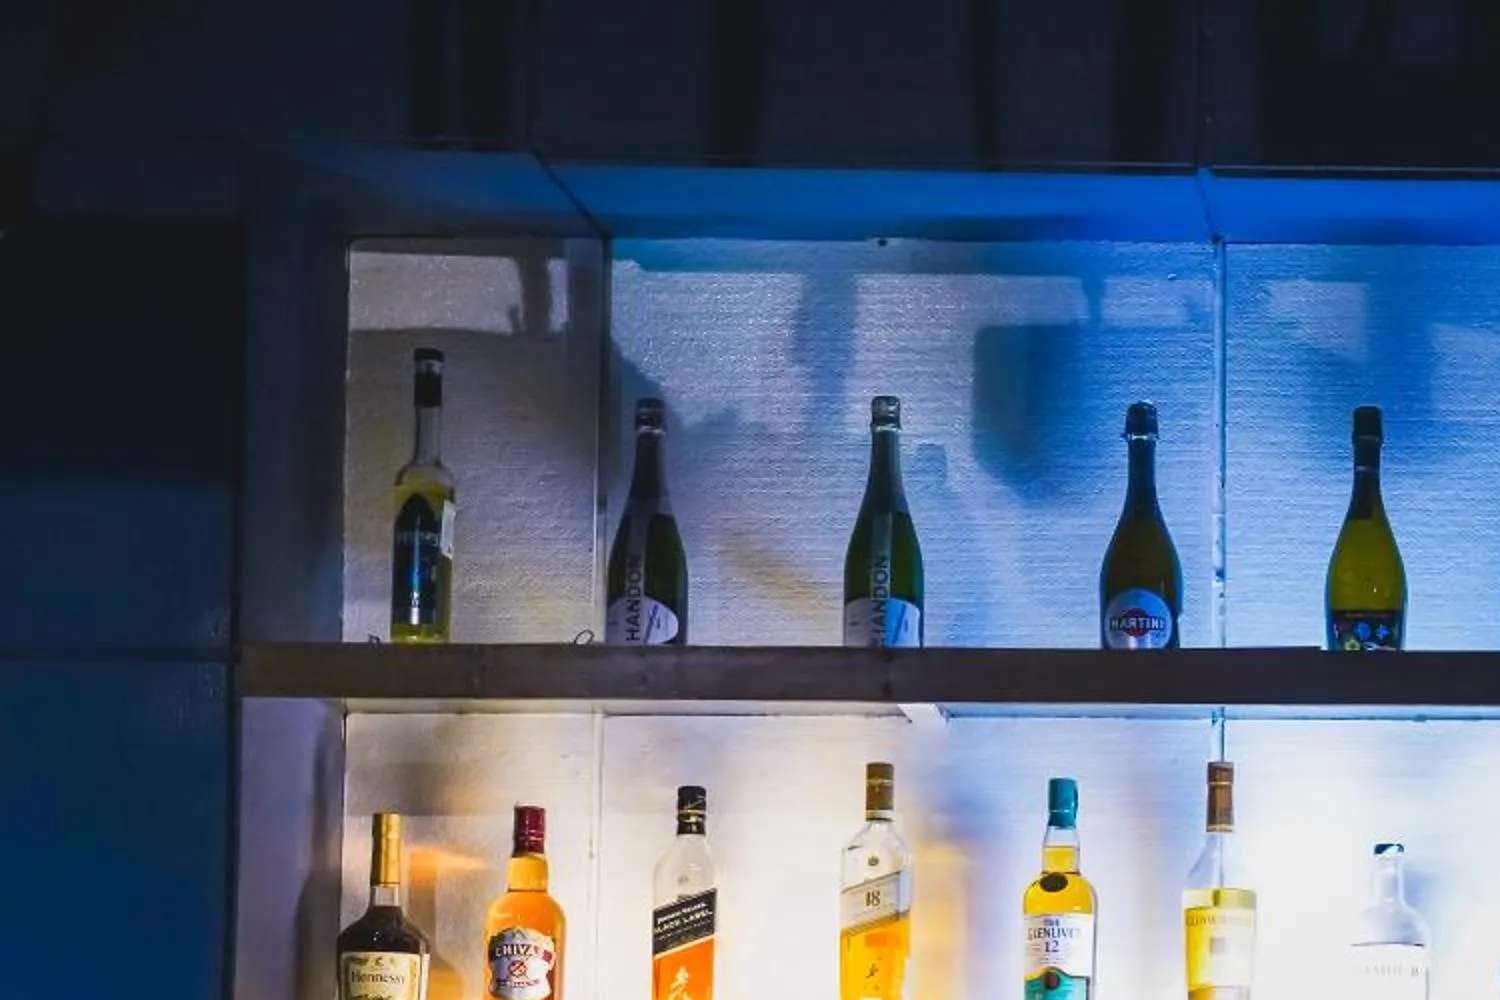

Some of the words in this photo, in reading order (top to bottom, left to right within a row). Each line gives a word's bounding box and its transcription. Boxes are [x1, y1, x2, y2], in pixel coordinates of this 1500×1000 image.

[625, 555, 642, 642] HANDON
[1109, 617, 1165, 631] MARTINI
[865, 890, 882, 907] 18
[1027, 927, 1080, 941] GLENLIVET
[1044, 940, 1060, 953] 12
[351, 970, 406, 987] Hennessy
